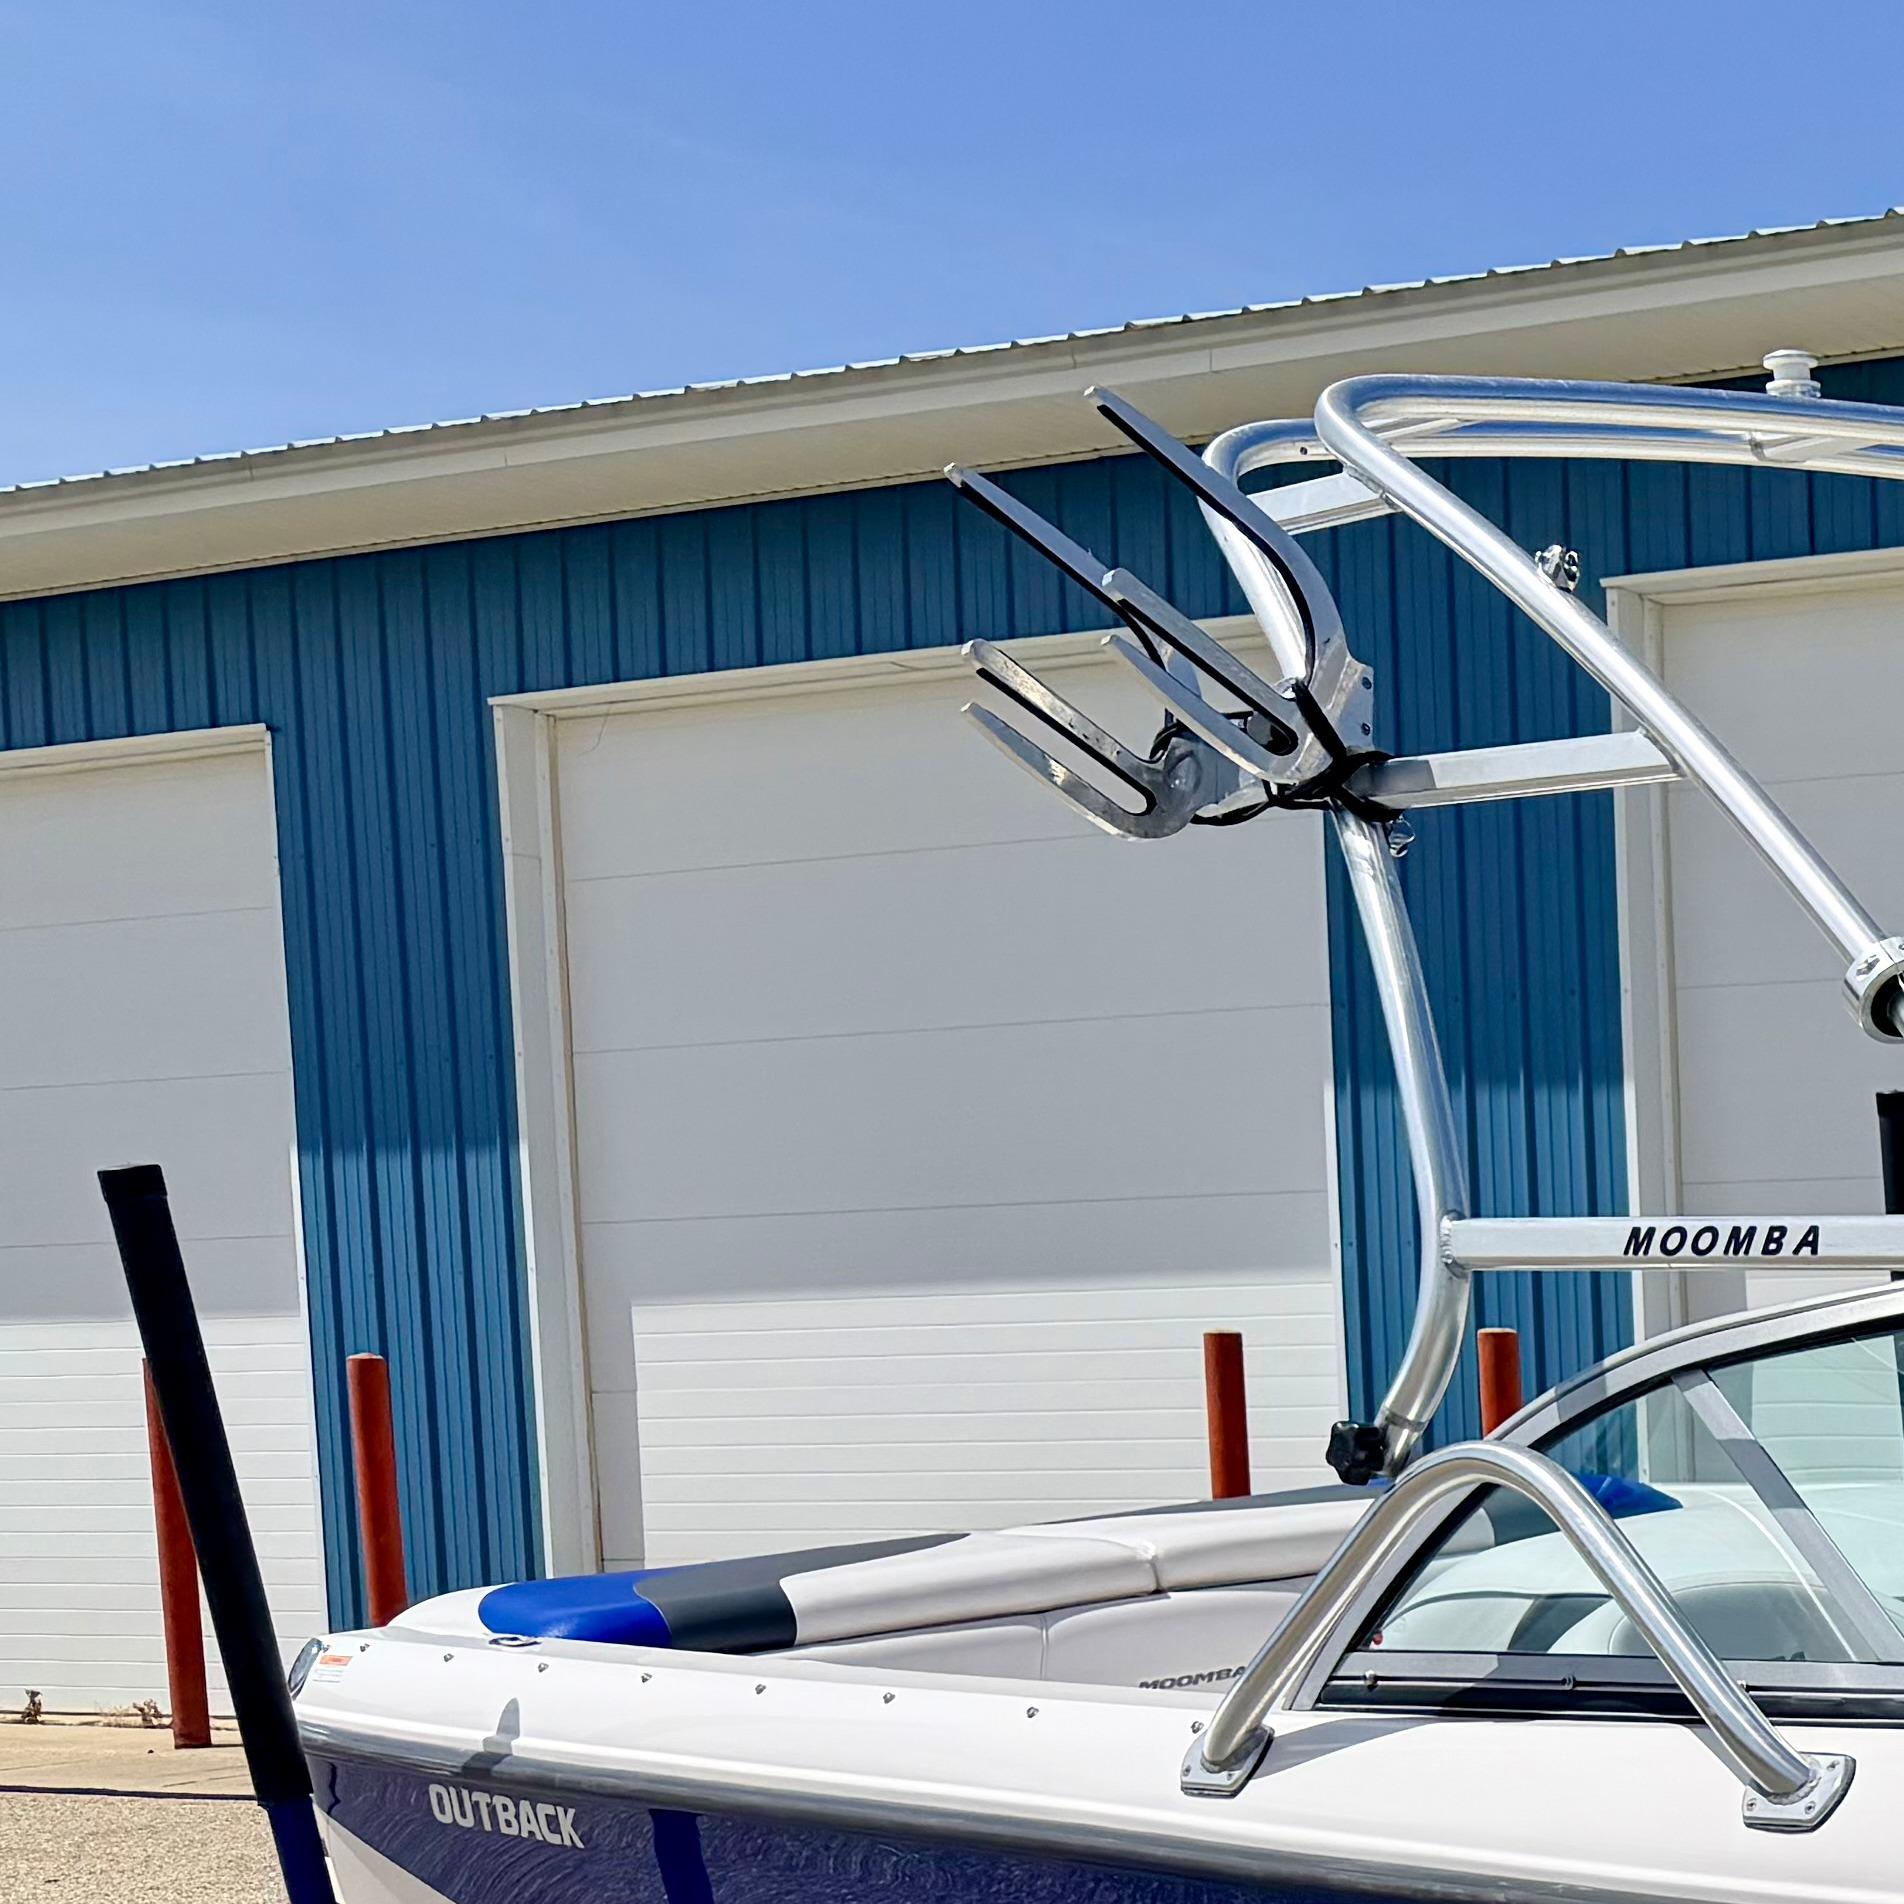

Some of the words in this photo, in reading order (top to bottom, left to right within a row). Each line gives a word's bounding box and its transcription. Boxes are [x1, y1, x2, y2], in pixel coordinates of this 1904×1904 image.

[1623, 1224, 1820, 1256] MOOMBA
[1139, 1666, 1247, 1690] MOOMBA
[428, 1783, 585, 1849] OUTBACK
